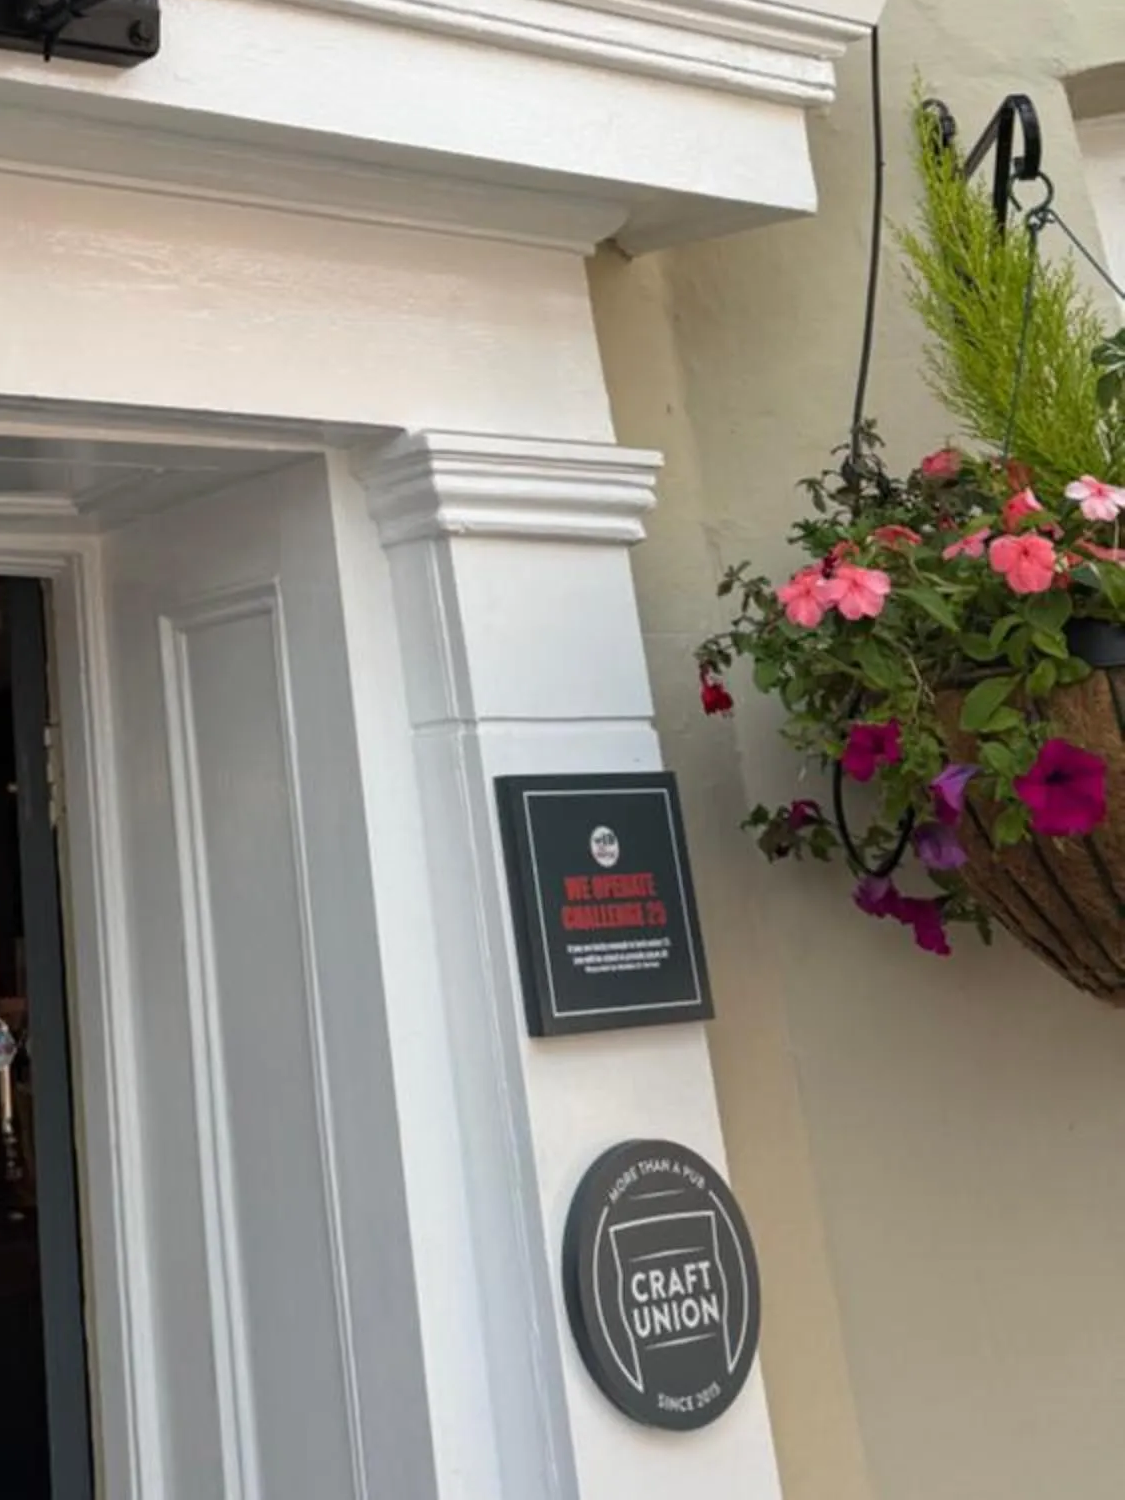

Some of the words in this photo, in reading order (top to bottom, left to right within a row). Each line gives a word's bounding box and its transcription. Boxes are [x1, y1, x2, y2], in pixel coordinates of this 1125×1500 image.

[608, 1165, 639, 1204] MORE
[638, 1157, 671, 1177] THAN
[672, 1160, 682, 1175] A
[682, 1164, 706, 1189] PUB
[631, 1260, 711, 1303] CRAFT
[633, 1293, 720, 1338] UNION
[657, 1392, 694, 1412] SINCE
